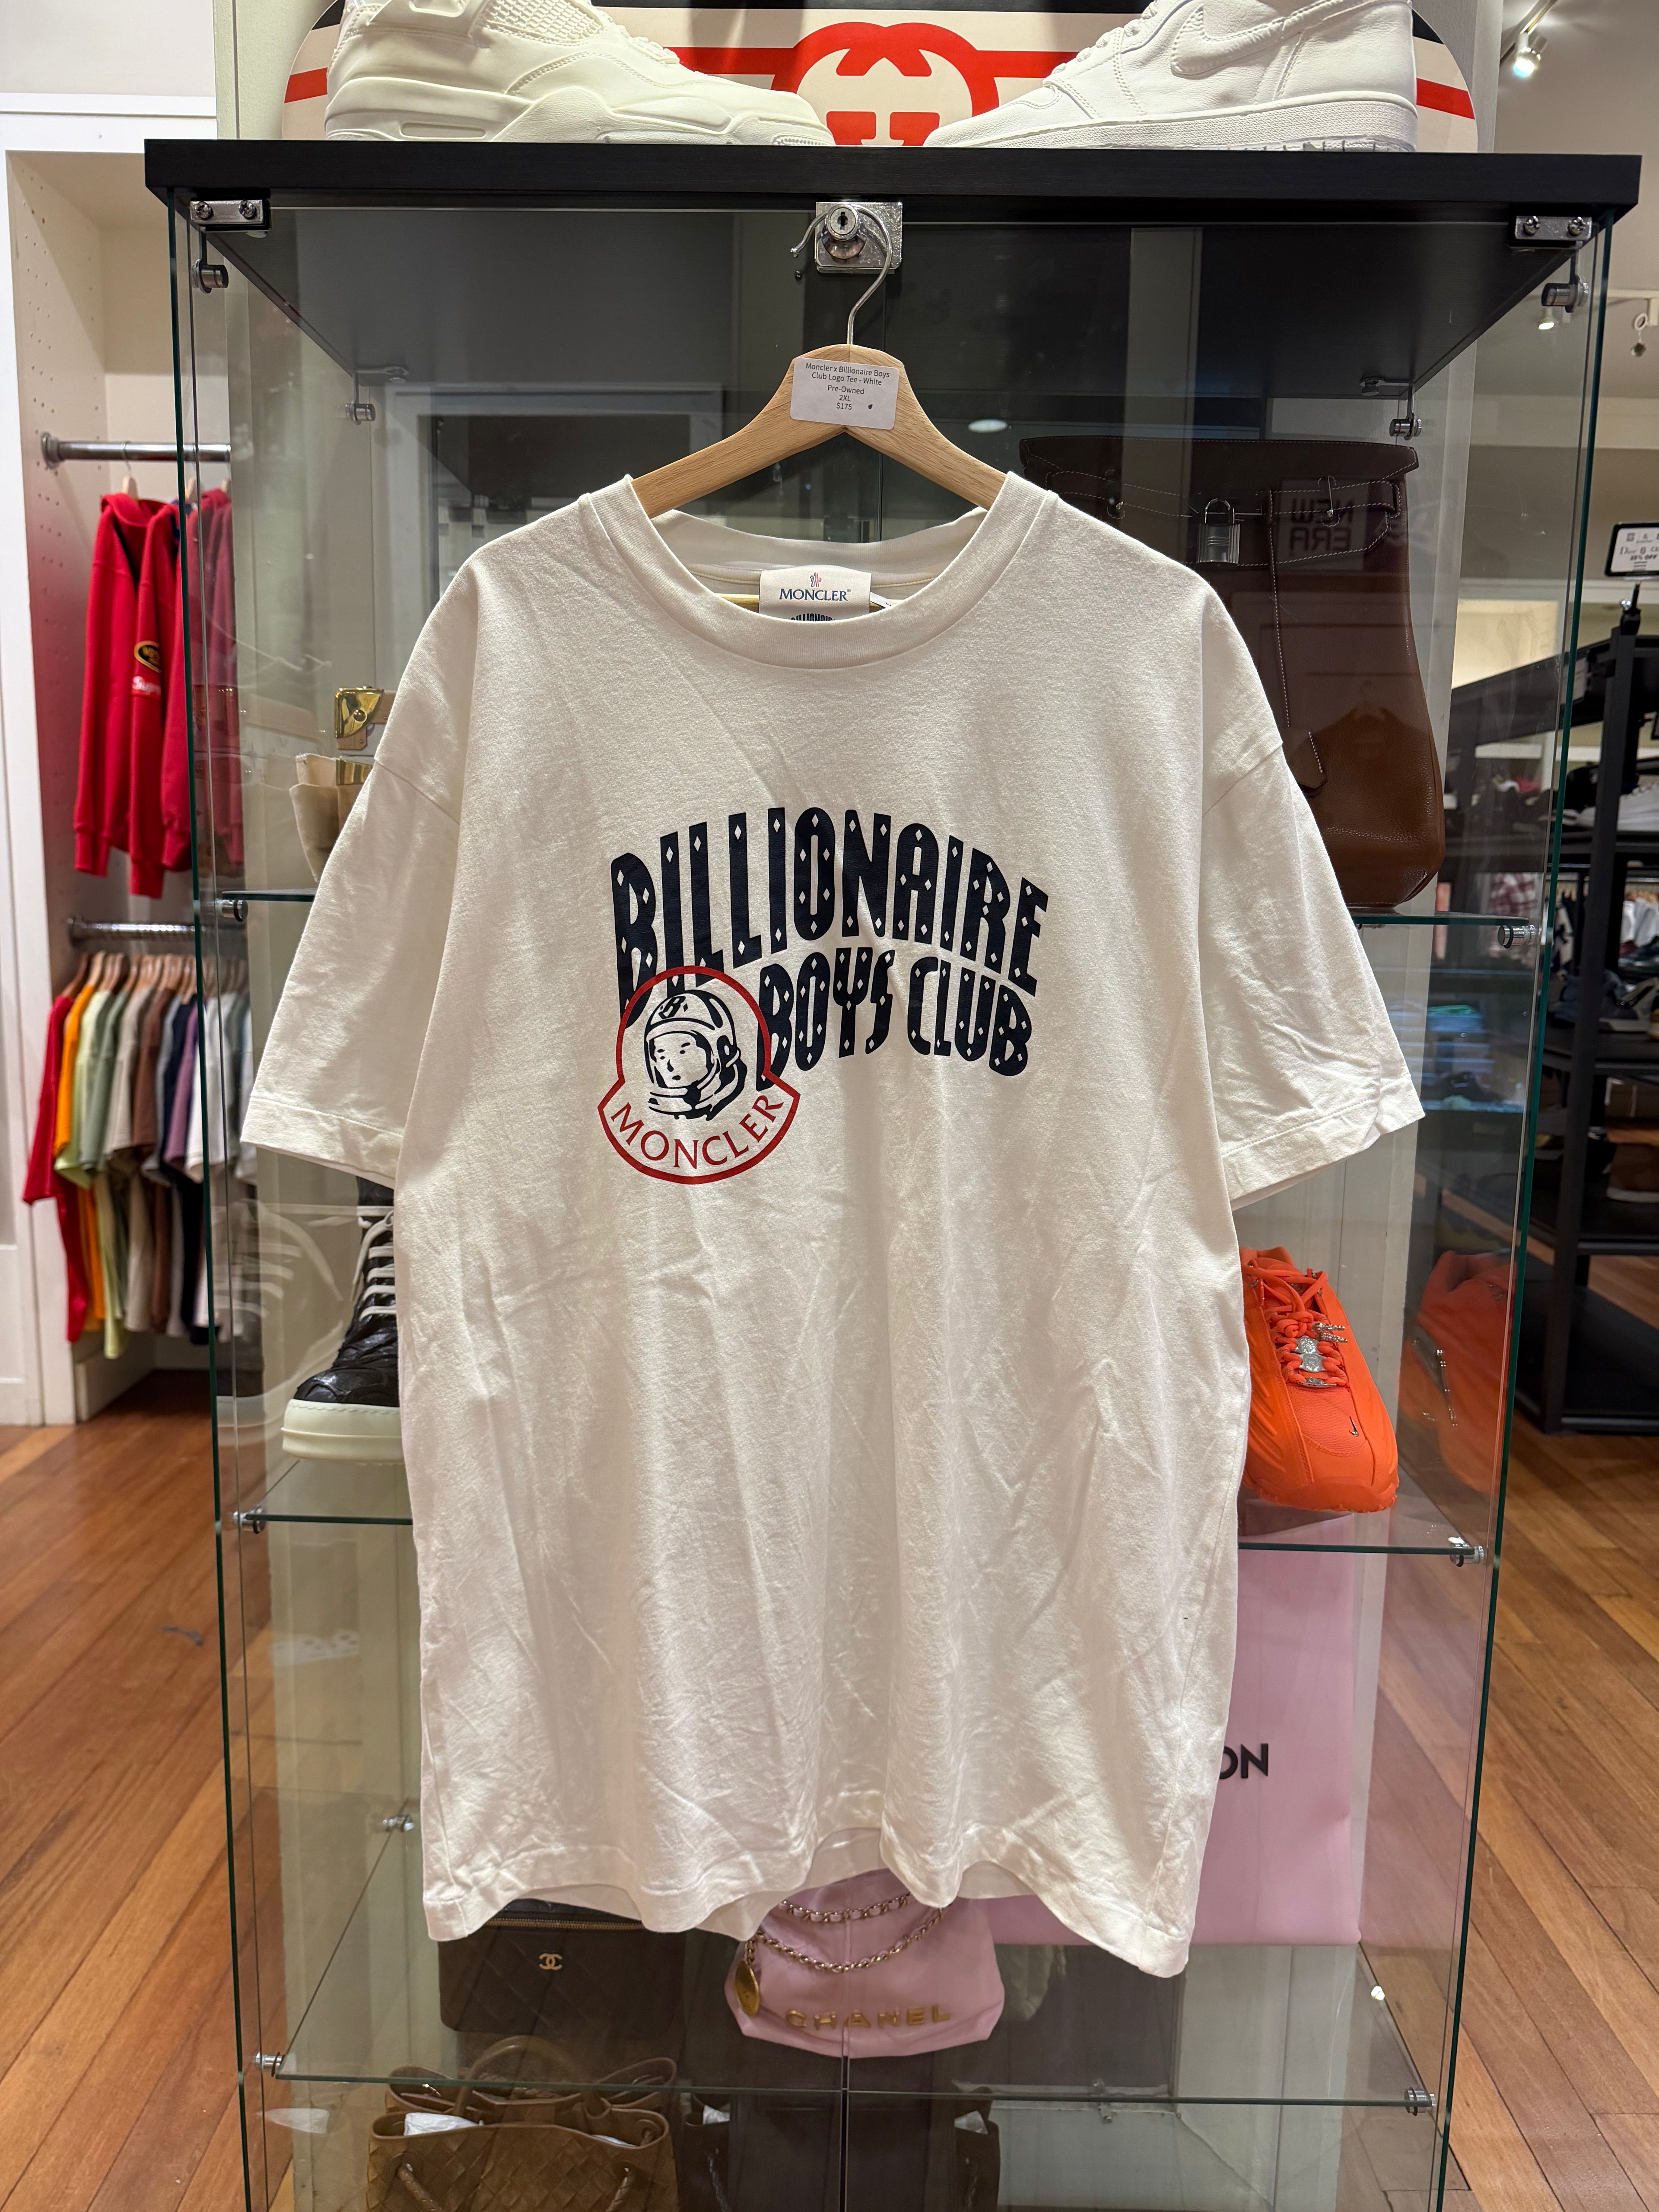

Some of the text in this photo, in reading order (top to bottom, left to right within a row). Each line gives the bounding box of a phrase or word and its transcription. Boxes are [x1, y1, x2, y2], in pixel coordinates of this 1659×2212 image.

[806, 362, 833, 371] Moncler
[839, 366, 872, 375] Billionaire
[874, 370, 890, 378] Boys
[811, 372, 827, 380] Club
[828, 374, 845, 383] Logo
[863, 377, 882, 386] White
[827, 385, 864, 394] Pre-Owned
[836, 402, 852, 410] $175
[779, 588, 849, 601] MONCLER
[610, 807, 1049, 1029] BILLIONAIRE
[756, 947, 1032, 1092] BOYS CLUB
[610, 1095, 784, 1170] MONCLER
[786, 2004, 951, 2030] CHANEL
